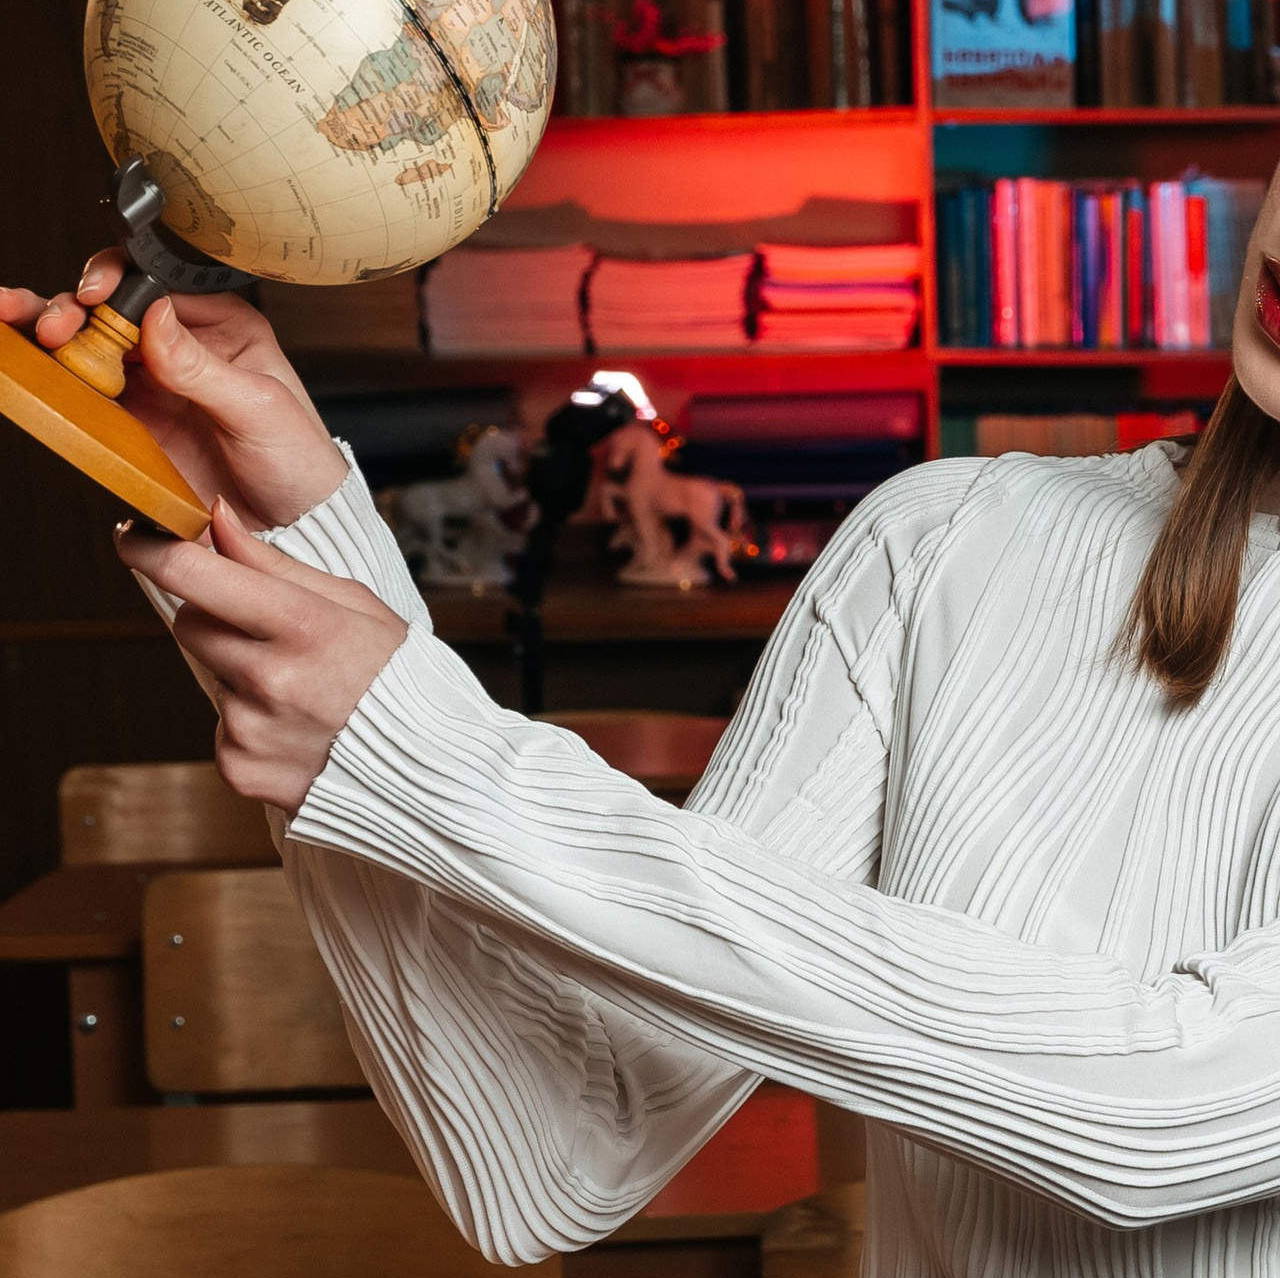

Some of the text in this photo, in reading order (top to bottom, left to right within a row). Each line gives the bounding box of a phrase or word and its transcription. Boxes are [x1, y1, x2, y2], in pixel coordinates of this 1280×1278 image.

[478, 36, 493, 62] SUDAN
[261, 49, 306, 95] OCEAN
[453, 194, 463, 229] INDIAN
